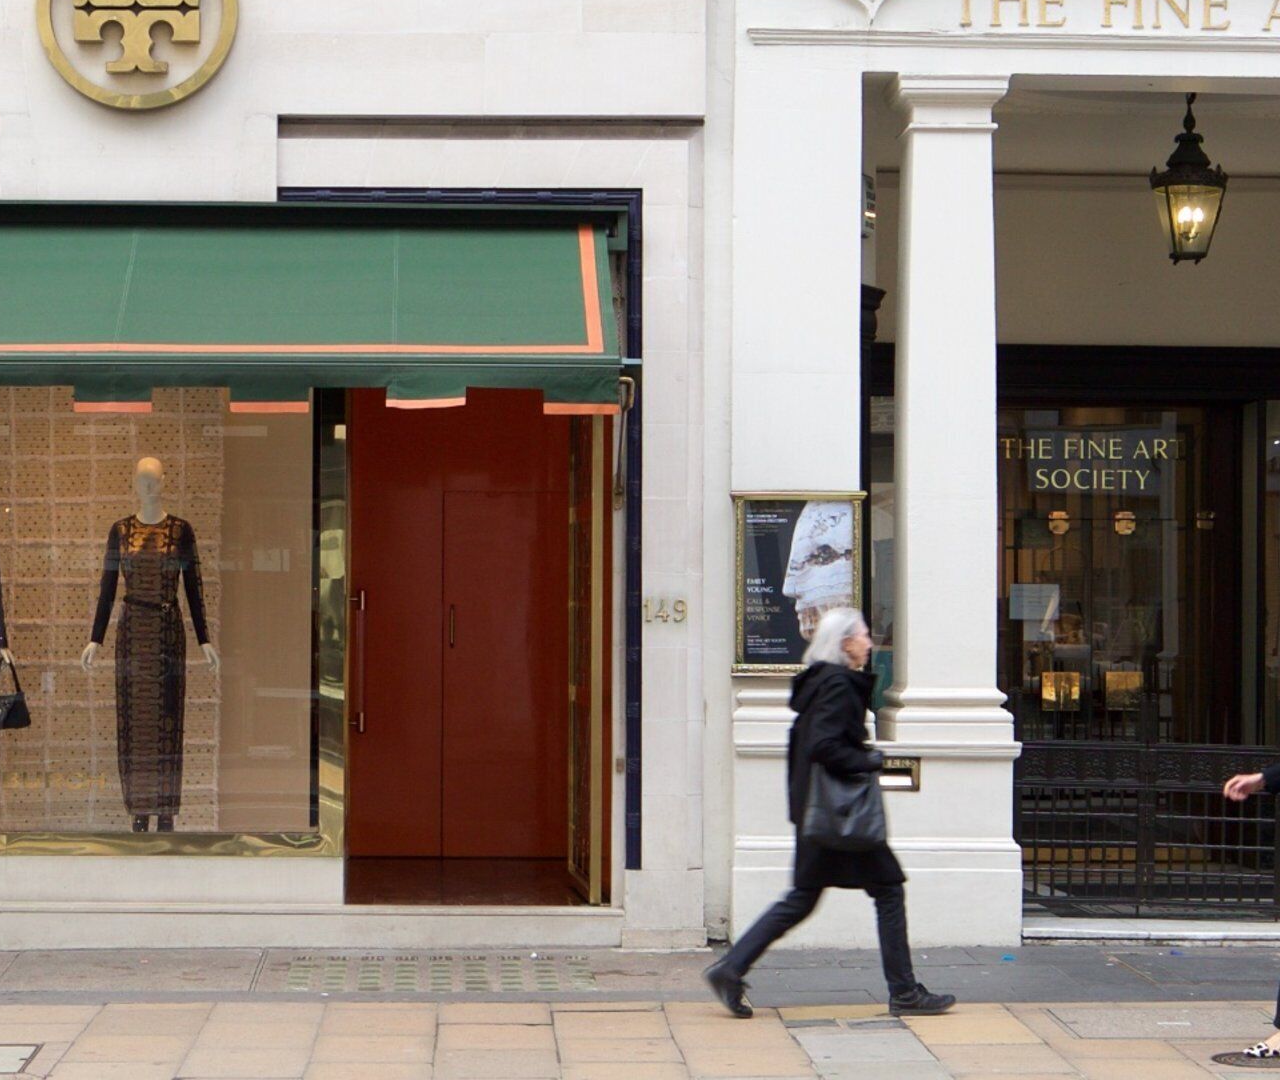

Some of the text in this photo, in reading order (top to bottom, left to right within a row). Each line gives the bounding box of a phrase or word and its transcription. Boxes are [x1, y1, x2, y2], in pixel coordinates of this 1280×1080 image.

[1000, 438, 1184, 460] THE FINE ART
[1035, 468, 1151, 490] SOCIETY
[643, 597, 688, 623] 149
